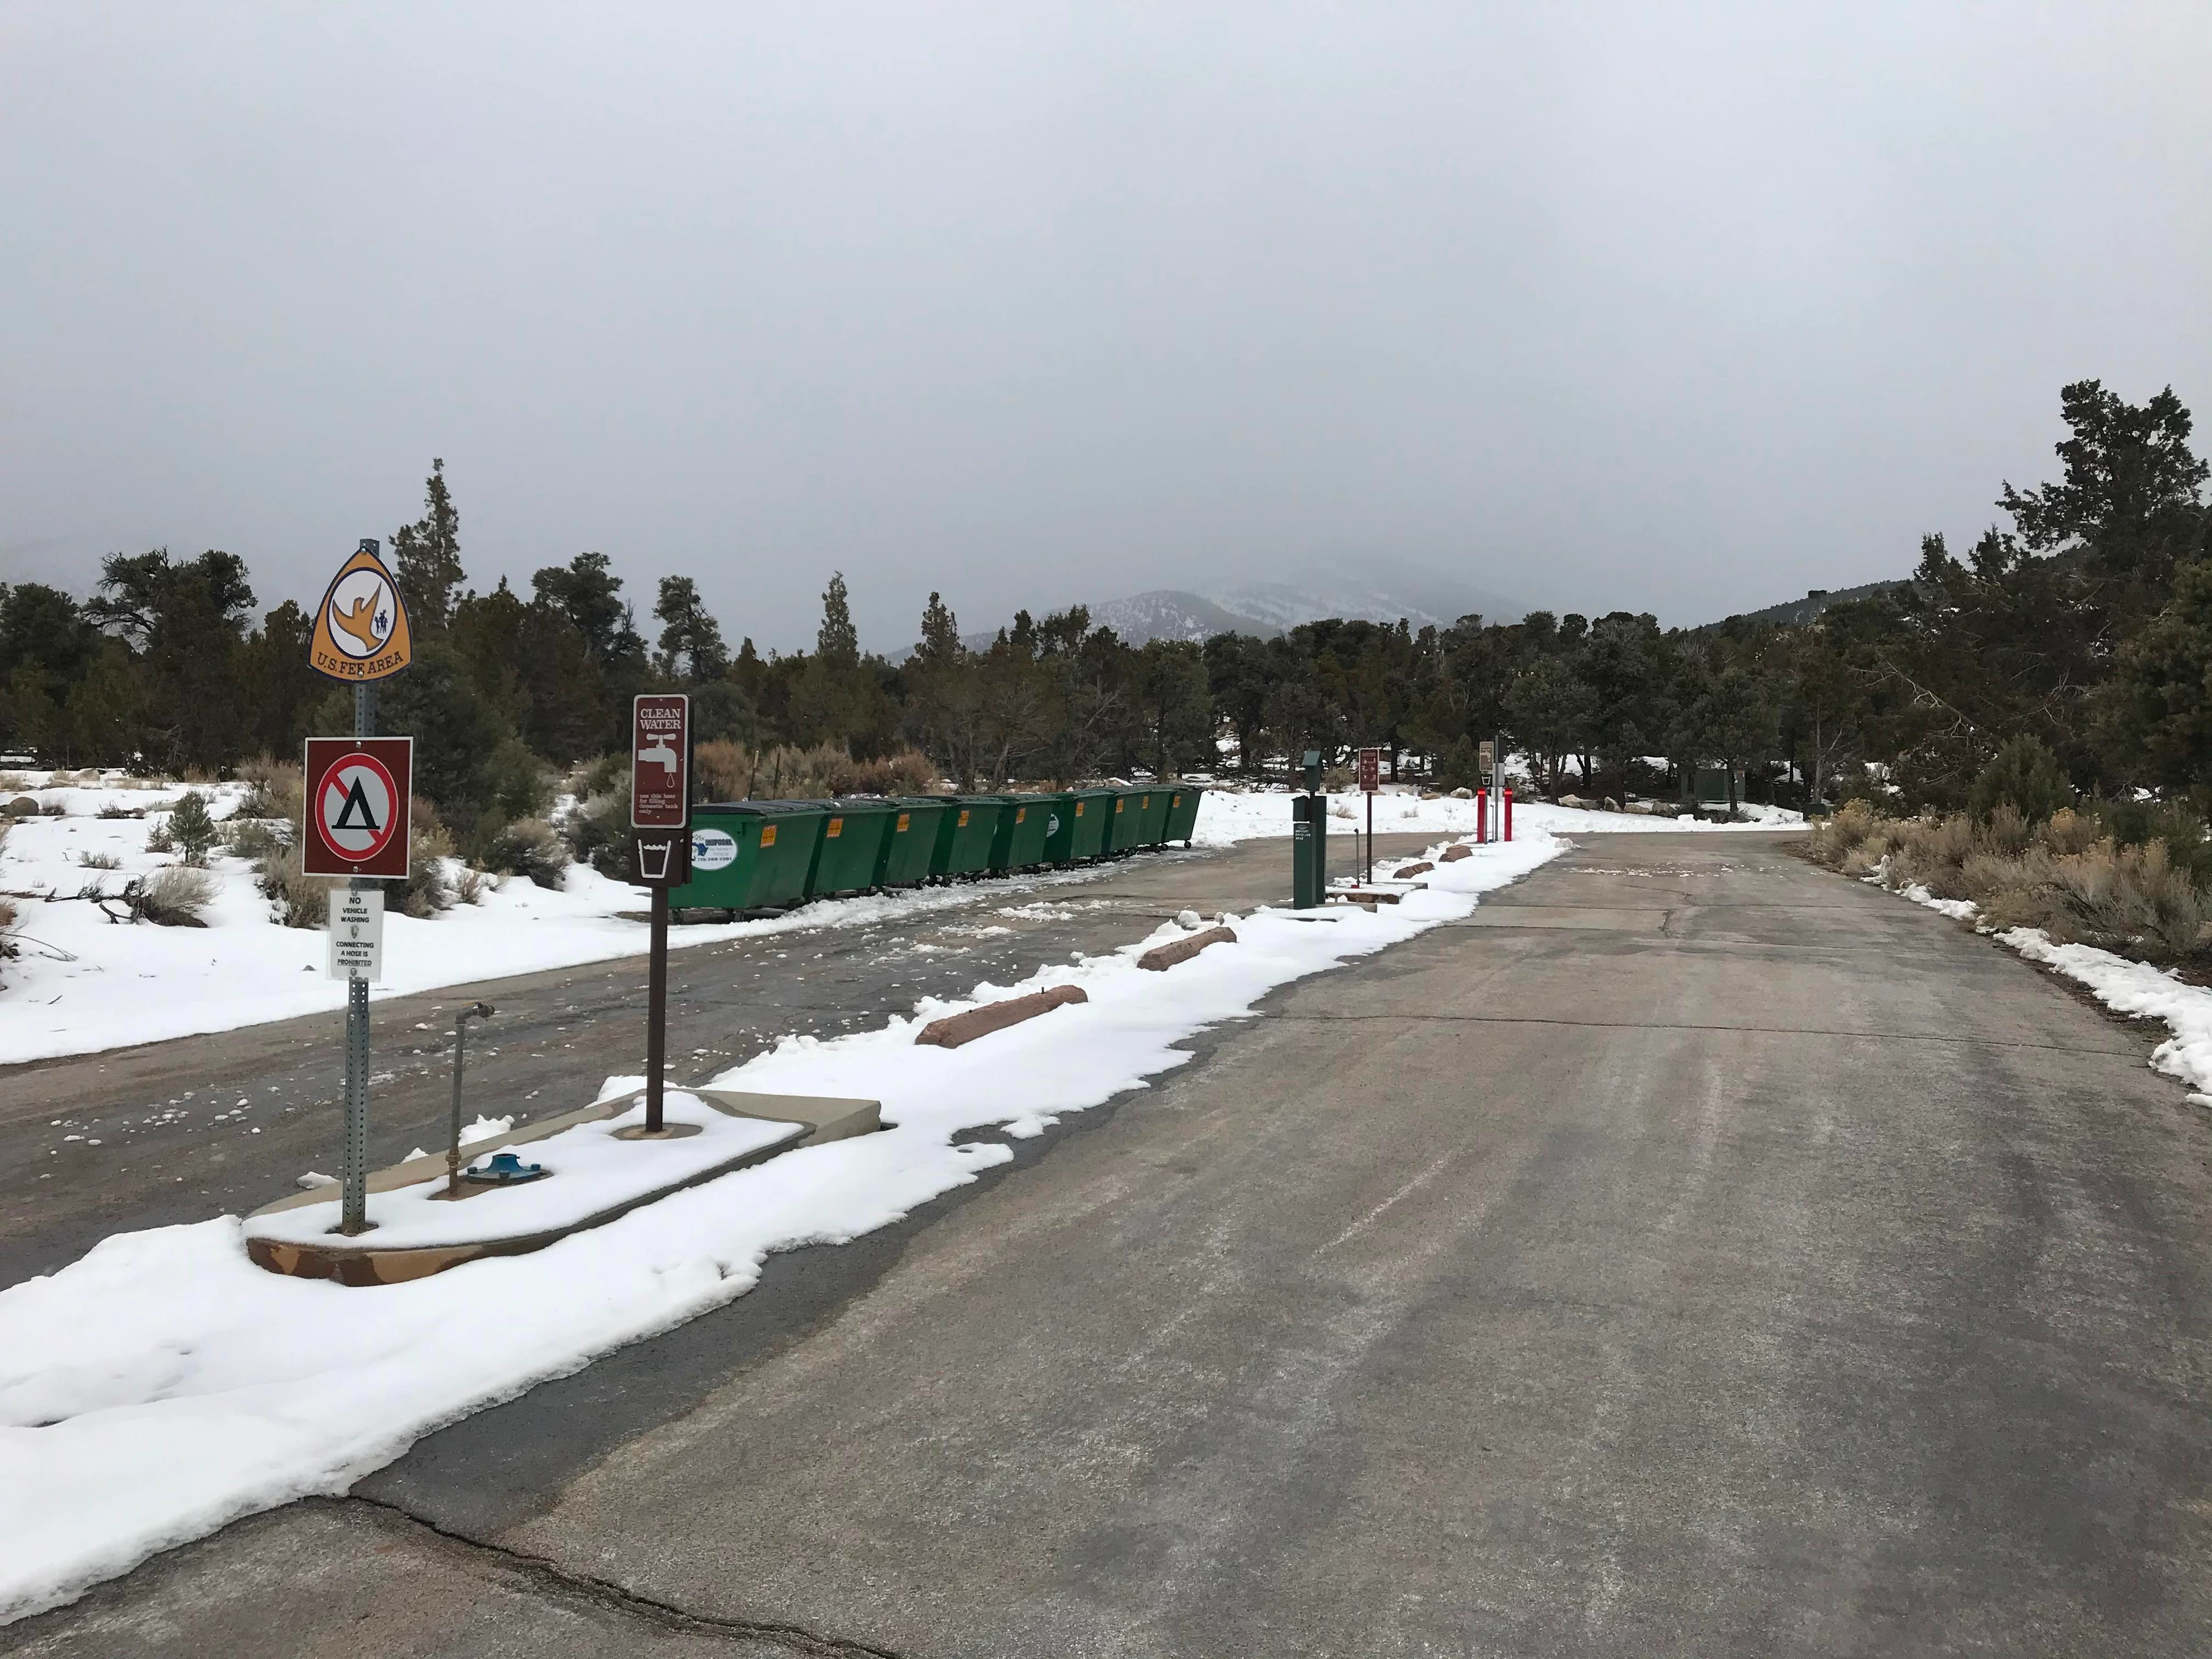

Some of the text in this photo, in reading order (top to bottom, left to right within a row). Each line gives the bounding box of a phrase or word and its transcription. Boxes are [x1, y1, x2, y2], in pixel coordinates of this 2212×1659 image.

[318, 651, 404, 675] U.S. FEE AREA
[640, 708, 681, 718] CLEAN
[639, 719, 681, 730] WATER
